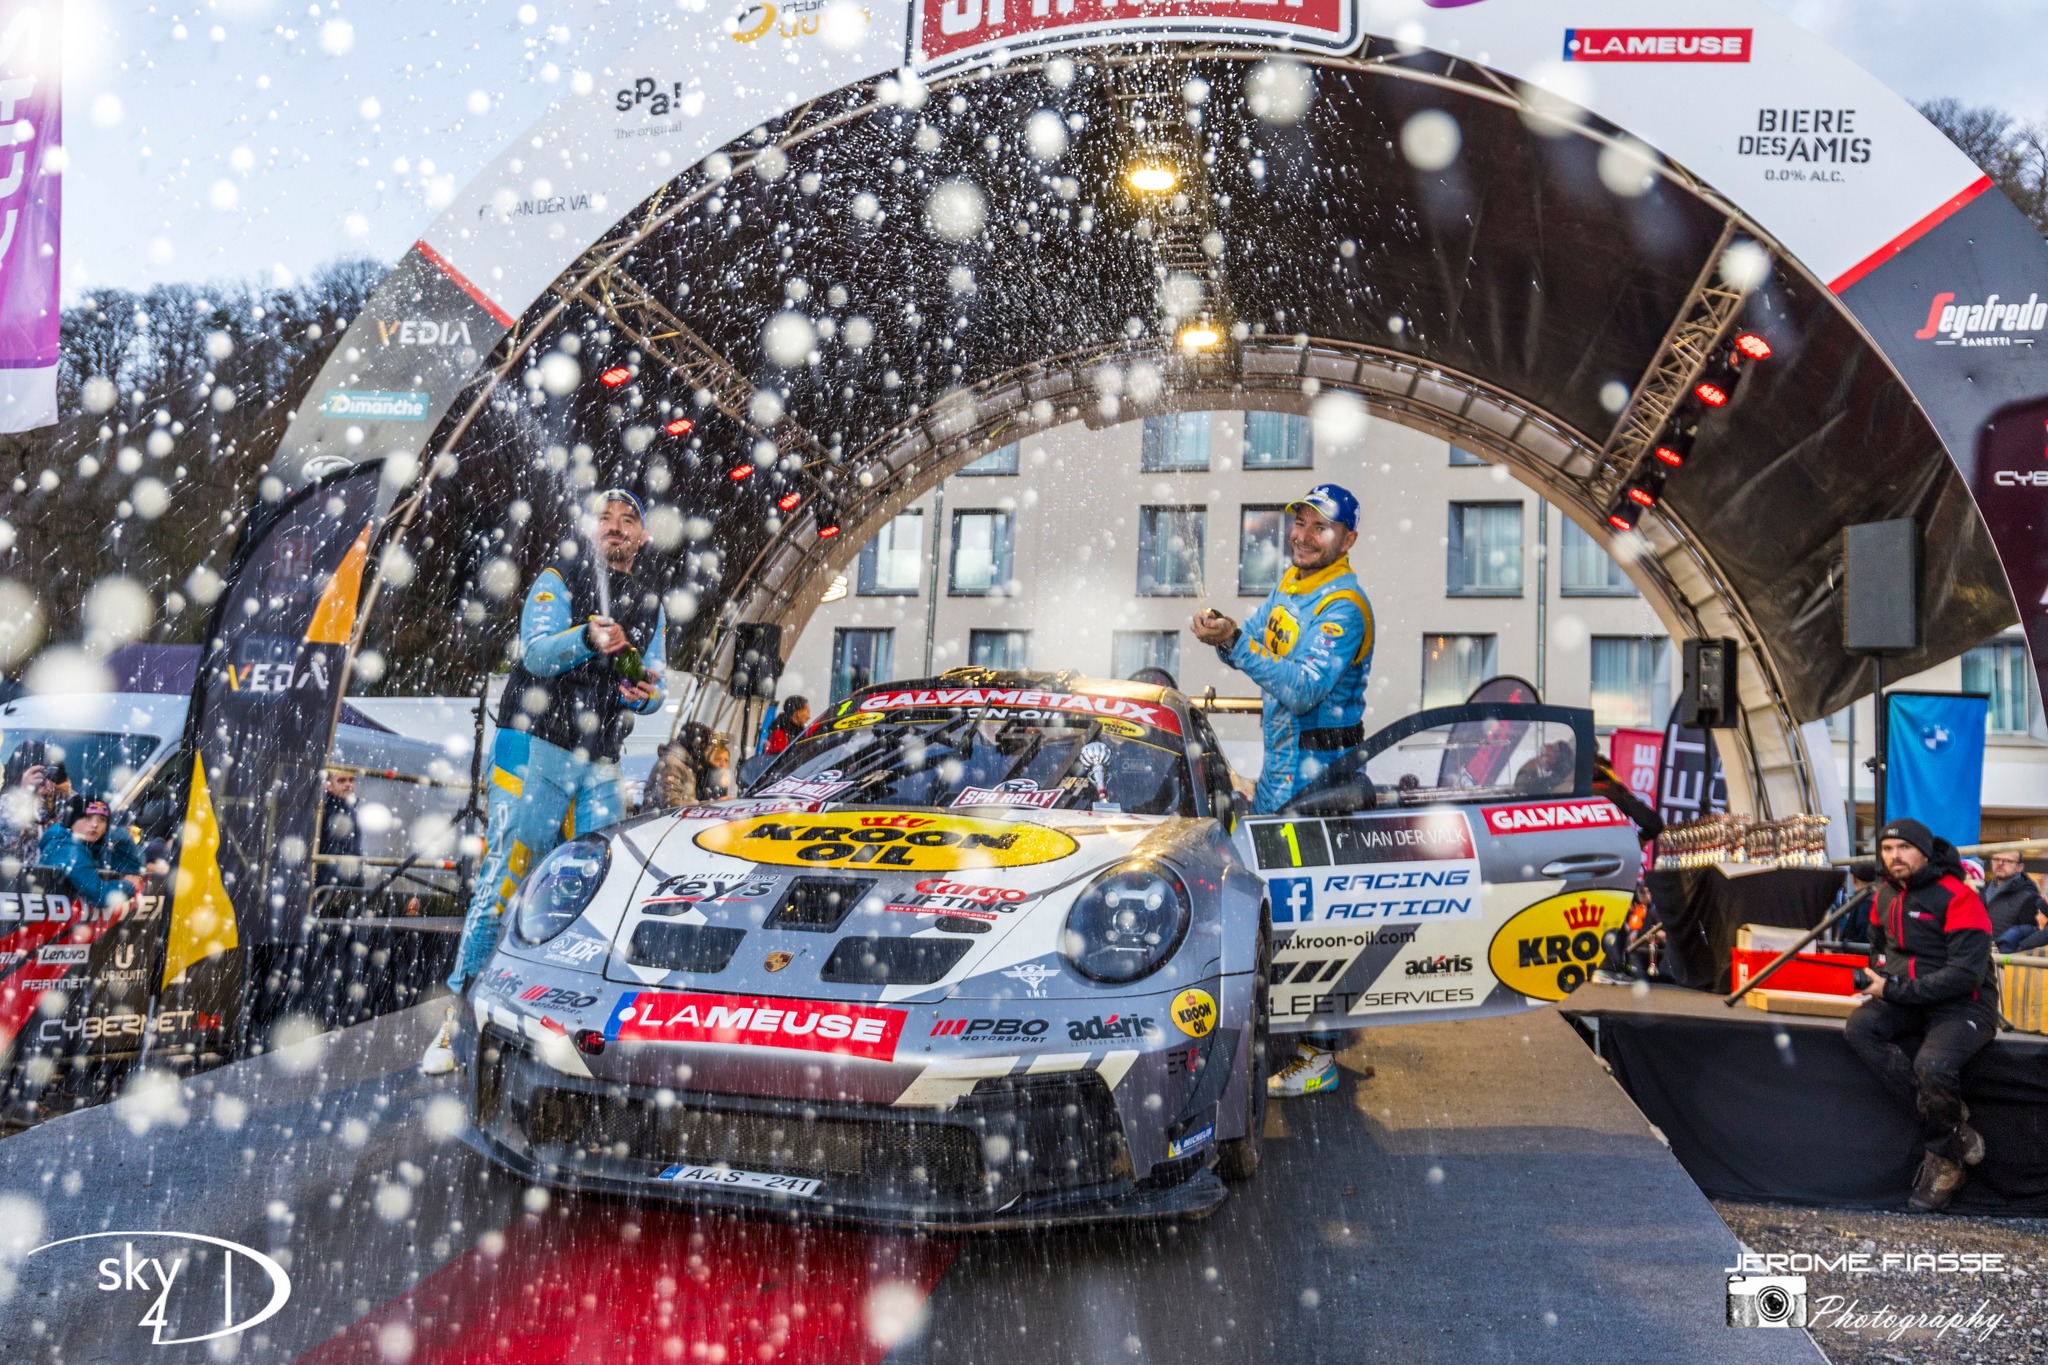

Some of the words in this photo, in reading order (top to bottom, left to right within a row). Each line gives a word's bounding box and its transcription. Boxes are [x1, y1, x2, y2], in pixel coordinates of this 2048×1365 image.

[1584, 36, 1742, 55] LAMEUSE
[616, 76, 683, 116] spa!
[614, 128, 635, 140] The
[637, 121, 682, 137] original
[1758, 109, 1856, 133] BIERE
[1765, 168, 1806, 181] 0.0%
[1810, 170, 1846, 182] ALC.
[538, 197, 566, 214] DER
[1915, 291, 2048, 340] Segafredo
[1960, 337, 2010, 347] ZANETTI
[837, 700, 852, 716] 1
[860, 688, 1158, 726] GALVAMETAUX
[960, 790, 999, 805] SPA
[1000, 791, 1057, 807] RALLY
[1491, 803, 1629, 829] GALVAMET
[743, 821, 1022, 851] KROON
[1279, 822, 1303, 867] 1
[1361, 830, 1393, 848] VAN
[1395, 828, 1425, 845] DER
[1427, 827, 1467, 844] VALK
[796, 843, 917, 867] OIL
[691, 872, 782, 882] printing
[1323, 869, 1471, 892] RACING
[651, 874, 777, 903] feys
[915, 878, 1028, 905] Cargo
[889, 893, 1021, 914] LIFTING
[1325, 897, 1472, 920] ACTION
[938, 909, 993, 920] TECHNOLOGIES
[559, 940, 603, 962] JDR
[537, 987, 598, 1008] PBO
[1365, 988, 1475, 1007] SERVICES
[529, 1002, 583, 1015] MOTORSPORT
[1178, 1002, 1211, 1024] KROON
[638, 1002, 887, 1044] LAMEUSE
[965, 1018, 1050, 1038] PBO
[1193, 1018, 1208, 1035] OIL
[961, 1034, 1047, 1044] MOTORSPORT
[683, 1167, 745, 1183] AAS
[764, 1175, 812, 1193] 241
